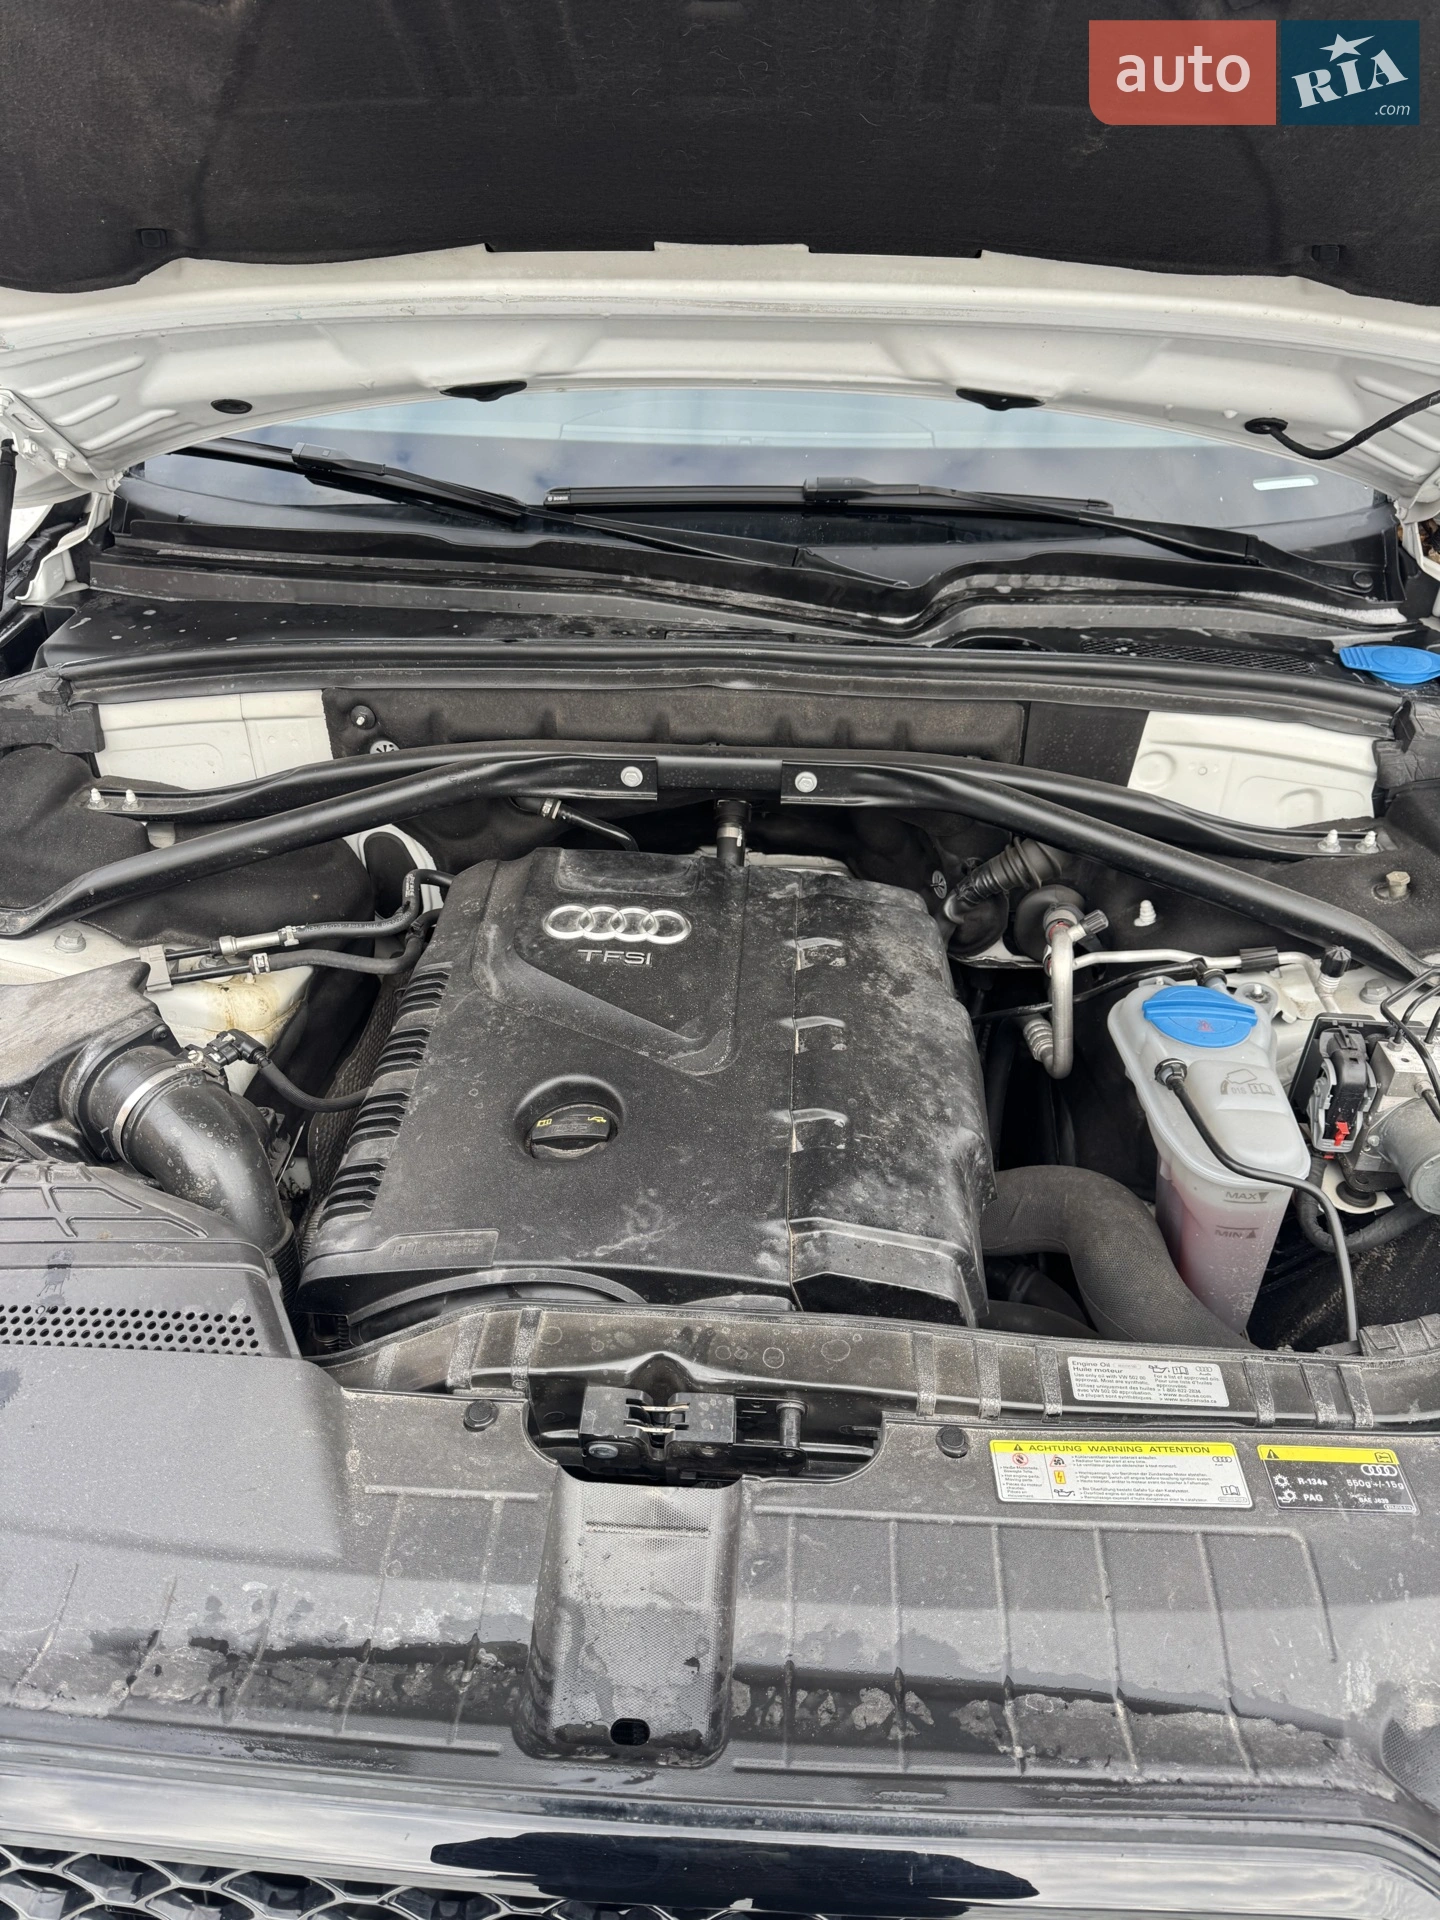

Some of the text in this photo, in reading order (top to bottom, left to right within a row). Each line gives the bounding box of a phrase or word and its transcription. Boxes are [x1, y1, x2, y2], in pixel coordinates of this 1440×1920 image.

[577, 949, 652, 966] TFSI
[1225, 1190, 1257, 1200] MAX
[1215, 1229, 1243, 1239] MIN
[1029, 1444, 1210, 1454] ACHTUNG WARNING ATTENTION
[1297, 1477, 1328, 1486] R-134a
[1346, 1479, 1371, 1489] 550g
[1303, 1493, 1324, 1502] PAG
